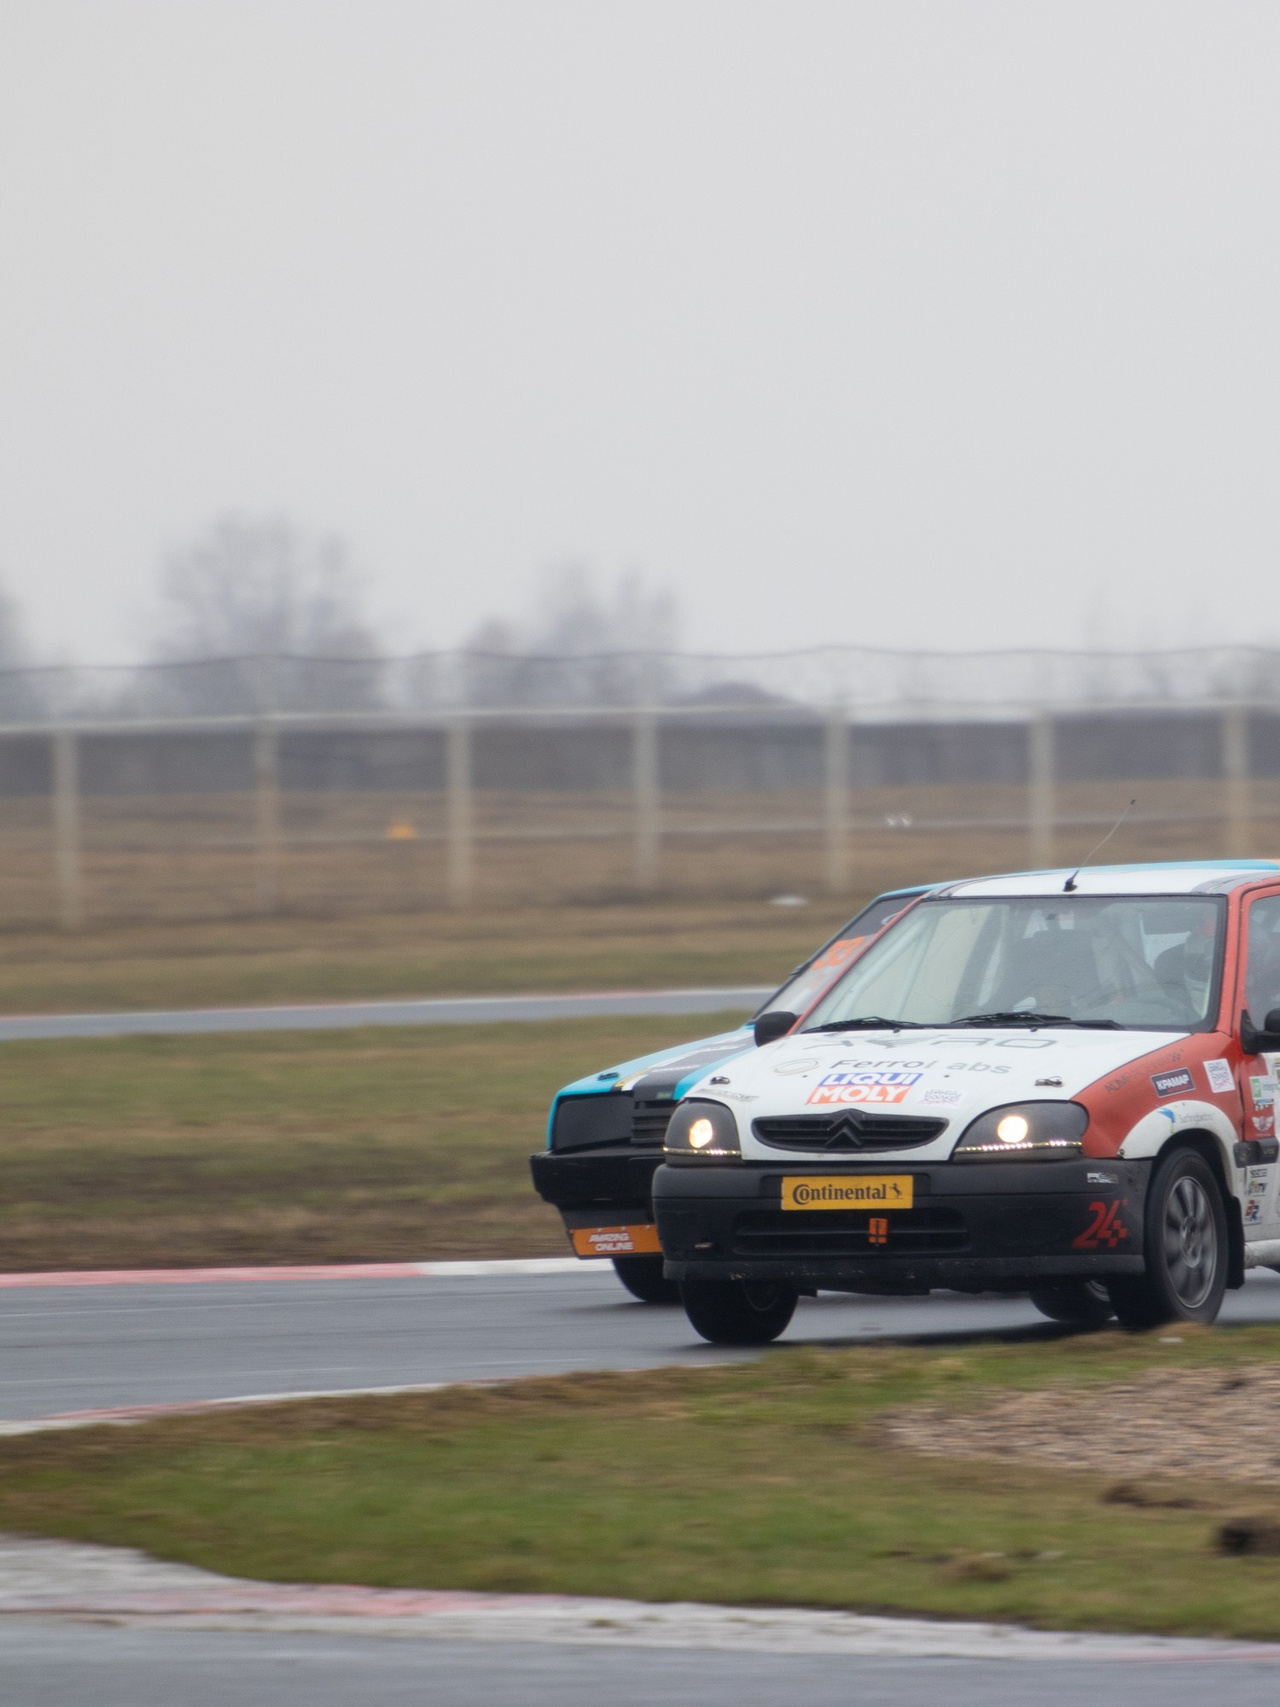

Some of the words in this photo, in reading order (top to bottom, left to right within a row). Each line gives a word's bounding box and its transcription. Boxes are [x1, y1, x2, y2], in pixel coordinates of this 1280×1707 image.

[823, 1073, 917, 1085] LIQUI
[814, 1085, 909, 1103] MOLY
[793, 1184, 887, 1205] Continental
[1072, 1199, 1127, 1249] 24
[589, 1233, 629, 1242] AMAZING
[595, 1242, 634, 1251] ONLINE
